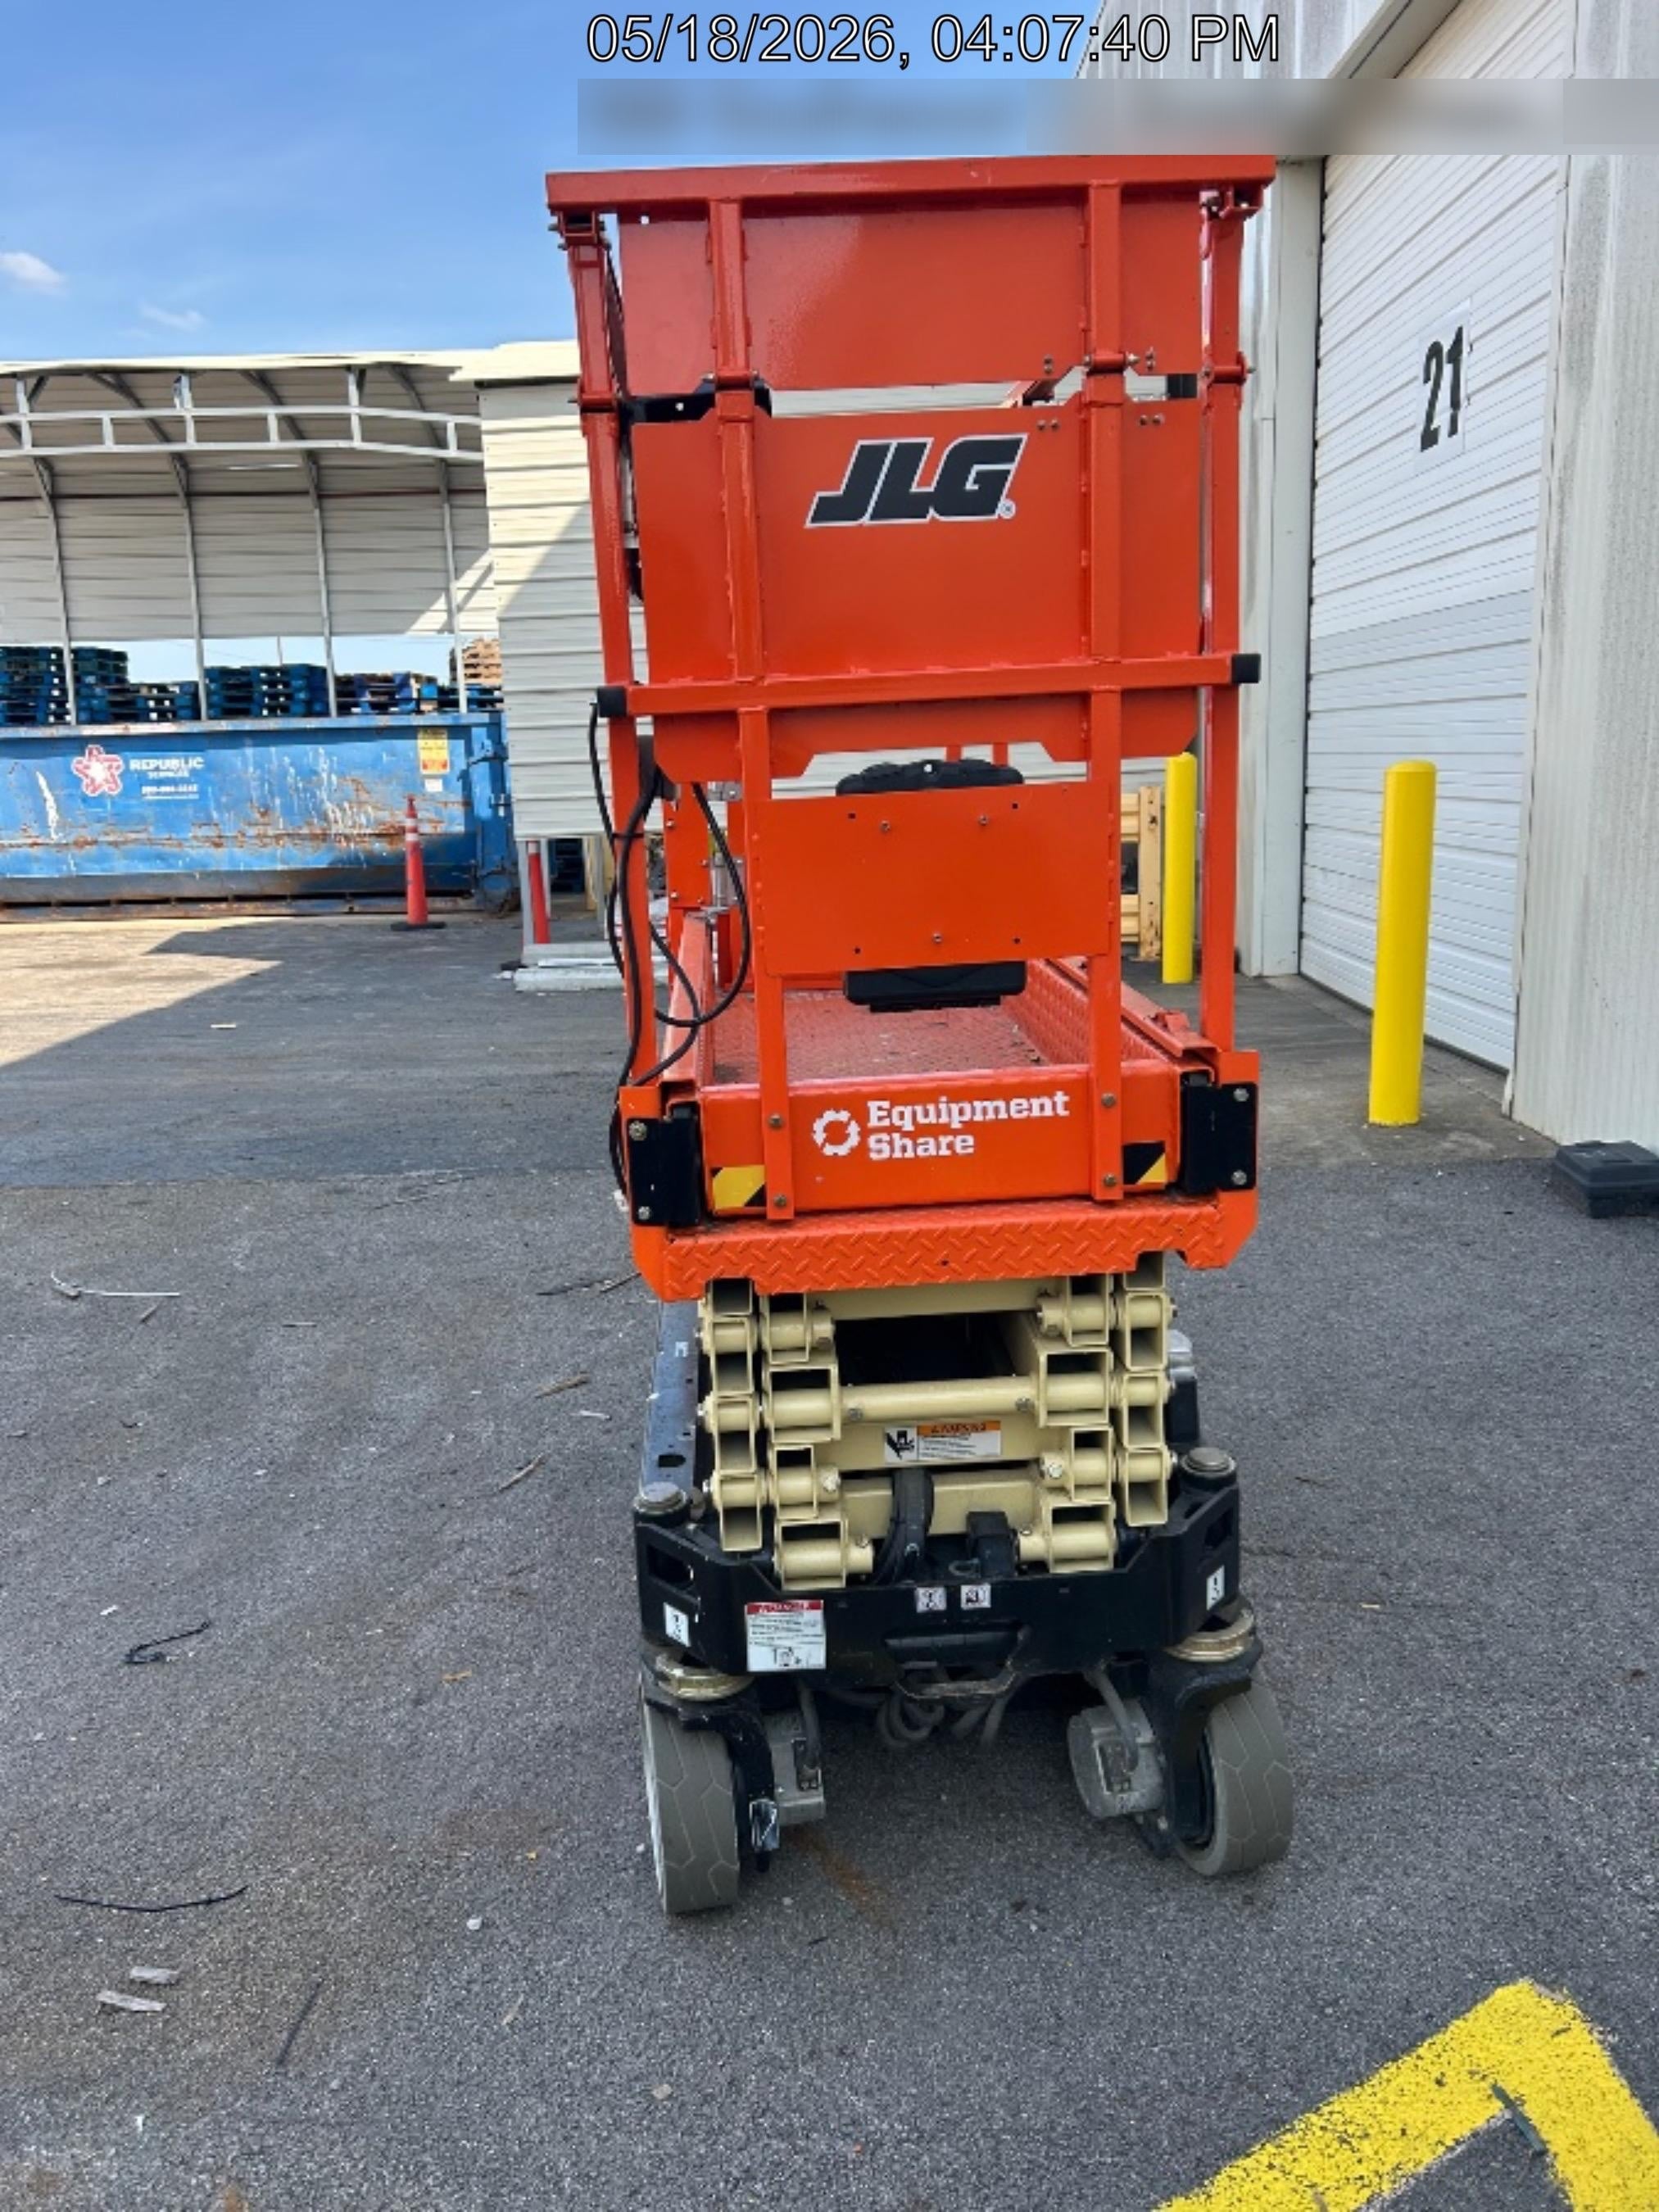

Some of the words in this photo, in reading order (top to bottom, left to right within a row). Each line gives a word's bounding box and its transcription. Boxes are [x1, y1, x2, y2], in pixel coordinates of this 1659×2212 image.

[1421, 325, 1463, 452] 21
[804, 433, 1028, 528] JLG
[129, 756, 204, 771] REPUBLIC
[867, 1090, 1070, 1131] Equipment
[868, 1132, 975, 1160] Share
